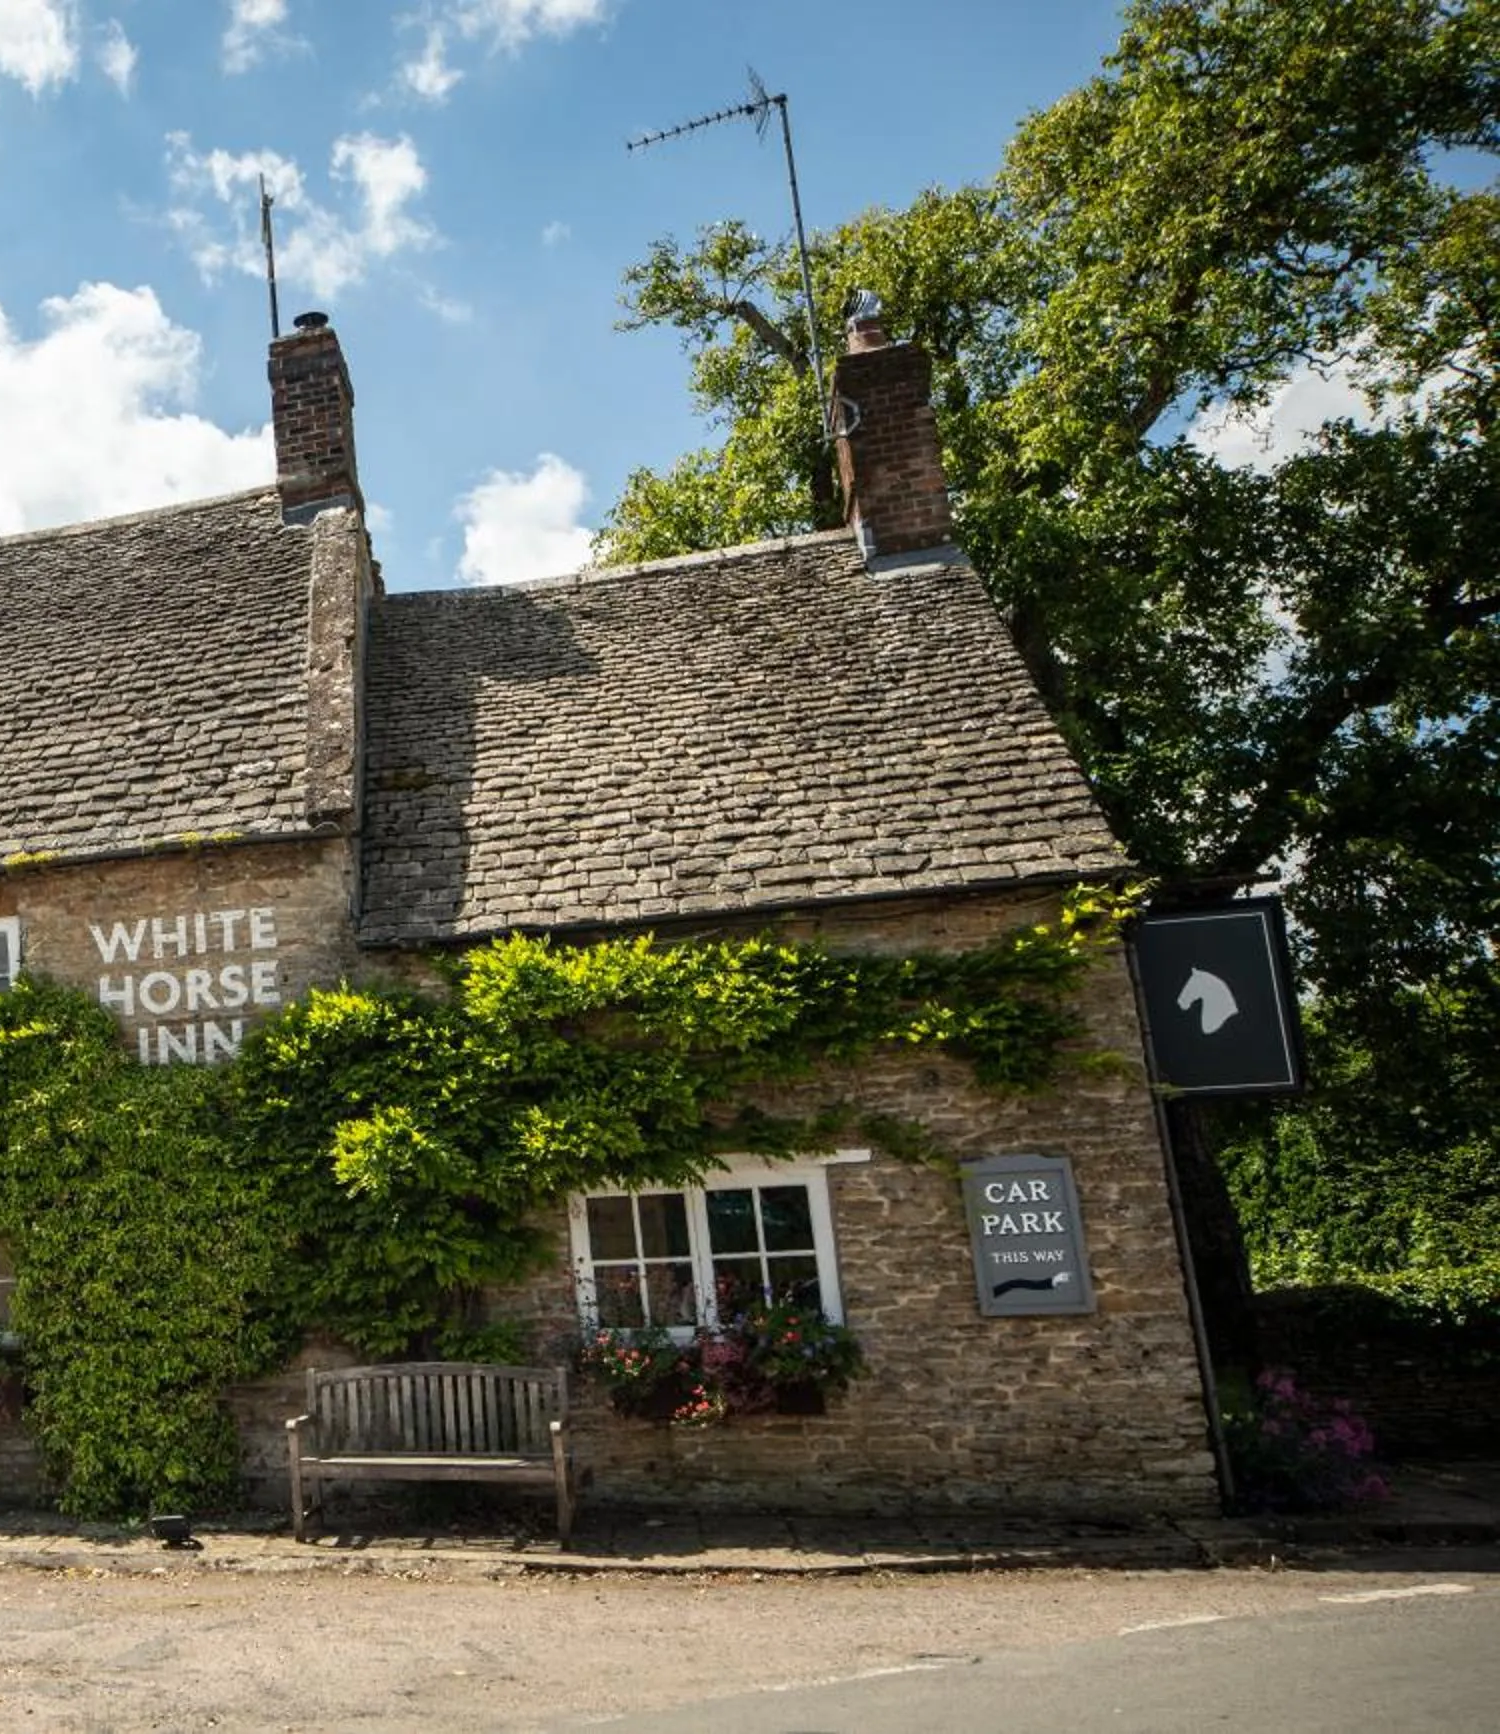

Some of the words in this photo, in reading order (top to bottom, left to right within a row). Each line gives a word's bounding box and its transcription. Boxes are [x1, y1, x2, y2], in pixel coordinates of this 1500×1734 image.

[89, 907, 278, 964] WHITE
[99, 959, 282, 1016] HORSE
[138, 1020, 243, 1065] INN
[985, 1179, 1050, 1204] CAR
[982, 1211, 1066, 1235] PARK
[992, 1252, 1029, 1264] THIS
[1033, 1250, 1064, 1262] WAY
